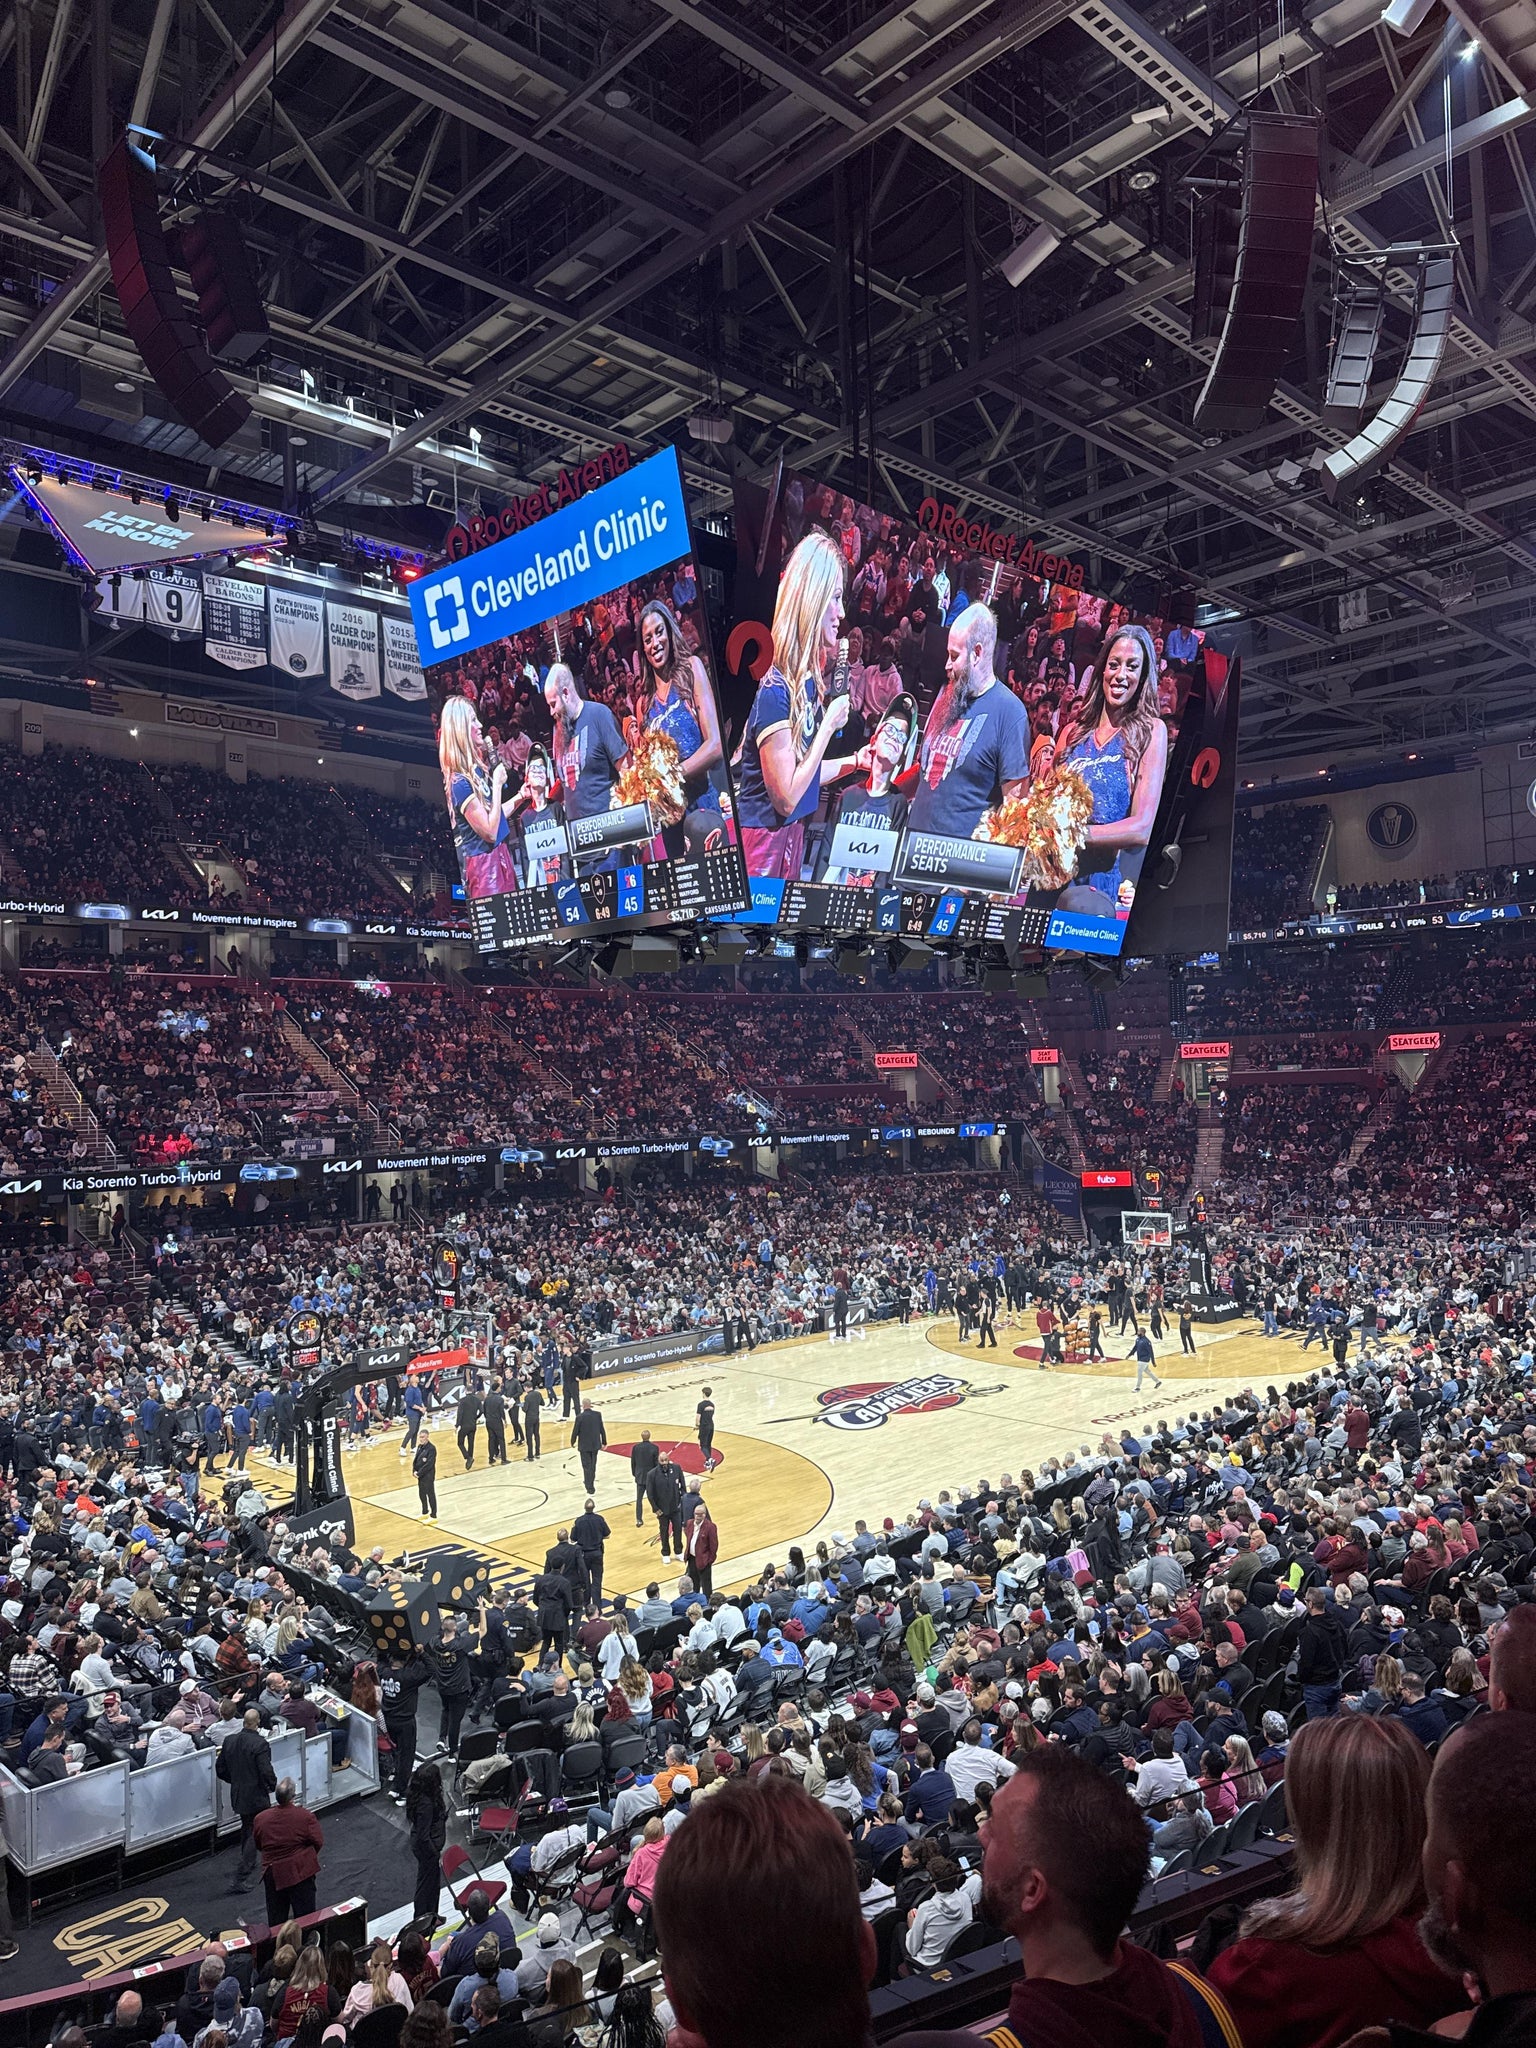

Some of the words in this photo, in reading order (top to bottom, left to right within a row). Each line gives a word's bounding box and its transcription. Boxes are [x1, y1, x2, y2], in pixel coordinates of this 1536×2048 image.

[469, 482, 551, 549] Rocket
[556, 443, 630, 501] Arena
[100, 511, 157, 529] LET
[151, 526, 194, 541] EM
[83, 519, 184, 549] KNOW.
[939, 503, 1016, 564] Rocket
[1016, 539, 1084, 587] Arena
[470, 530, 591, 618] Cleveland
[593, 496, 668, 561] Clinic
[150, 570, 198, 588] GLOVER
[206, 577, 262, 594] CLEVELAND
[216, 588, 254, 601] BARONS
[166, 590, 183, 623] 9
[276, 598, 293, 607] NORTH
[294, 601, 317, 612] DIVISION
[274, 604, 319, 622] CHAMPIONS
[342, 612, 363, 625] 2016
[330, 623, 359, 638] CALDER
[360, 629, 376, 641] CUP
[390, 626, 415, 638] 2015-
[331, 635, 376, 653] CHAMPIONS
[391, 639, 418, 652] WESTER
[215, 647, 242, 658] CALDER
[243, 652, 257, 660] CUP
[217, 653, 257, 665] CHAMPIONS
[386, 650, 421, 663] CONFEREN
[388, 660, 424, 675] CHAMPION
[25, 724, 41, 733] 209
[229, 753, 243, 762] 210
[576, 812, 625, 833] PERFORMANCE
[578, 830, 603, 845] SEATS
[848, 841, 879, 856] KIA
[914, 837, 987, 863] PERFORMANCE
[911, 854, 948, 873] SEATS
[580, 882, 591, 893] 2Q
[607, 876, 612, 887] 7
[624, 897, 638, 912] 45
[755, 893, 777, 905] Clinic
[930, 898, 935, 907] 7
[0, 902, 65, 914] urbo-Hybrid
[142, 909, 179, 920] KIA
[193, 912, 241, 924] Movement
[243, 915, 261, 926] that
[263, 916, 298, 929] inspires
[365, 924, 396, 934] KIA
[406, 926, 418, 937] Kia
[420, 927, 449, 938] Sorento
[566, 907, 580, 922] 54
[595, 906, 611, 920] 6:49
[671, 909, 694, 922] $5,710
[881, 913, 895, 926] 54
[907, 920, 923, 932] 6:49
[936, 919, 949, 932] 45
[1243, 931, 1267, 941] $5,710
[1316, 926, 1333, 935] TOL
[1338, 925, 1345, 934] 6
[1357, 922, 1384, 931] FOULS
[1390, 920, 1397, 929] 4
[1407, 918, 1426, 927] FG%
[1432, 916, 1444, 925] 53
[1491, 908, 1505, 919] 54
[527, 934, 554, 945] RAFFLE
[1064, 925, 1099, 938] Cleveland
[1099, 929, 1119, 941] Clinic
[1392, 1035, 1438, 1047] SEATGEEK
[1182, 1044, 1228, 1056] SEATGEEK
[877, 1054, 916, 1066] SEATGEEK
[63, 1178, 84, 1190] Kia
[87, 1174, 137, 1189] Sorento
[140, 1168, 221, 1187] Turbo-Hybrid
[323, 1160, 362, 1173] KIA
[377, 1156, 429, 1170] Movement
[431, 1154, 450, 1166] that
[451, 1152, 487, 1166] inspires
[556, 1147, 586, 1159] KIA
[597, 1146, 610, 1156] Kia
[611, 1144, 640, 1156] Sorento
[642, 1140, 689, 1154] Turbo-Hybrid
[748, 1135, 772, 1147] KIA
[780, 1133, 813, 1145] Movement
[815, 1133, 826, 1144] that
[827, 1132, 850, 1145] inspires
[900, 1127, 911, 1138] 13
[917, 1127, 956, 1137] REBOUNDS
[965, 1125, 976, 1135] 17
[1045, 1181, 1078, 1190] LECOM
[1097, 1175, 1116, 1184] fubo
[299, 1318, 317, 1330] 6:49
[369, 1352, 400, 1366] KIA
[505, 1357, 515, 1367] 45
[594, 1357, 619, 1371] KIA
[623, 1354, 634, 1364] Kia
[634, 1351, 656, 1363] Sorento
[657, 1344, 693, 1359] Turbo-Hybrid
[874, 1378, 921, 1400] CLEVELAND
[813, 1374, 969, 1431] CAVALIERS
[1104, 1399, 1166, 1422] Rocket
[1163, 1387, 1217, 1405] Arena
[326, 1431, 337, 1470] Cleveland
[328, 1470, 339, 1493] Clinic
[163, 1669, 174, 1683] 10
